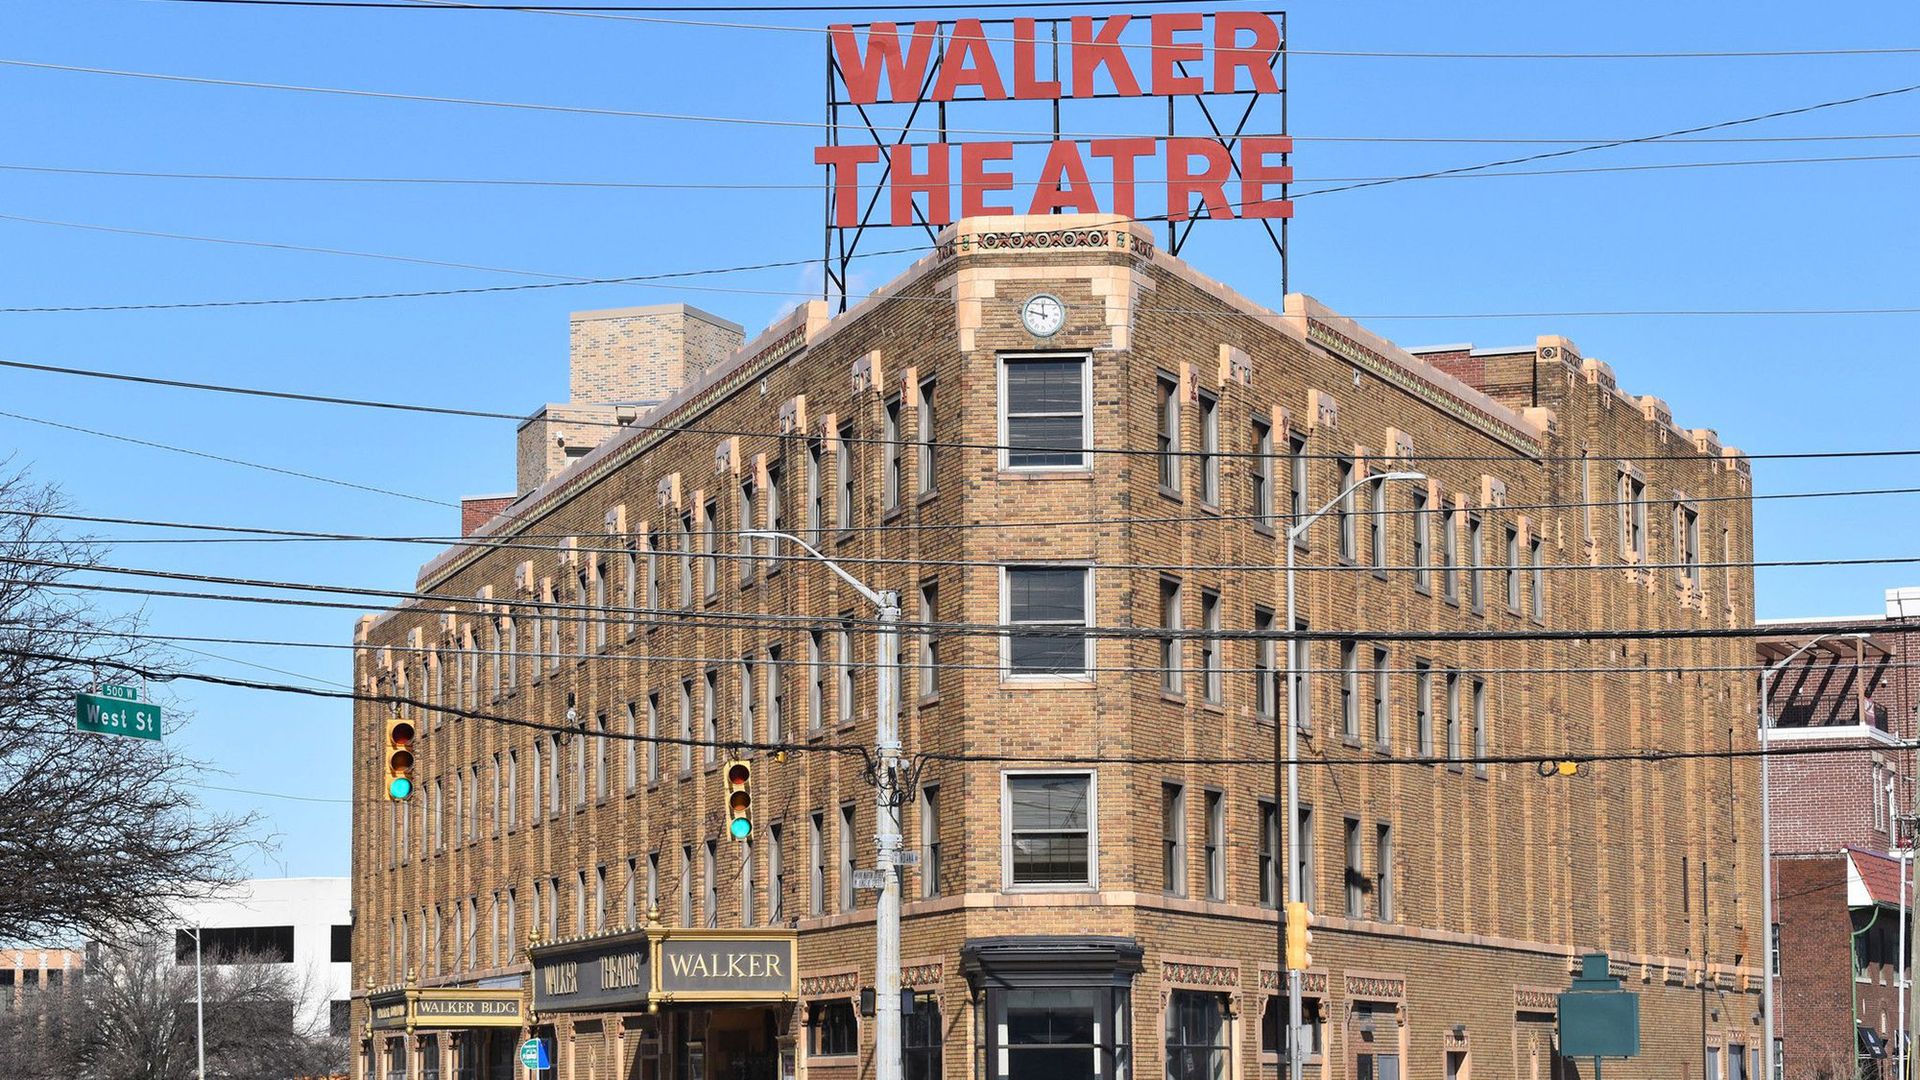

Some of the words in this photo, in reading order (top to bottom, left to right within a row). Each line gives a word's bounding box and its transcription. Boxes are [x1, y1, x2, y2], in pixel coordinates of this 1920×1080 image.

[831, 12, 1280, 104] WALKER
[814, 136, 1294, 228] THEATRE
[106, 685, 124, 697] 500
[126, 688, 133, 699] W
[87, 704, 127, 728] West
[136, 711, 153, 732] St
[544, 961, 578, 996] WALKER
[601, 952, 640, 990] THEATRE
[667, 953, 784, 978] WALKER
[420, 1001, 475, 1014] WALKER
[481, 1001, 517, 1014] BLDG.
